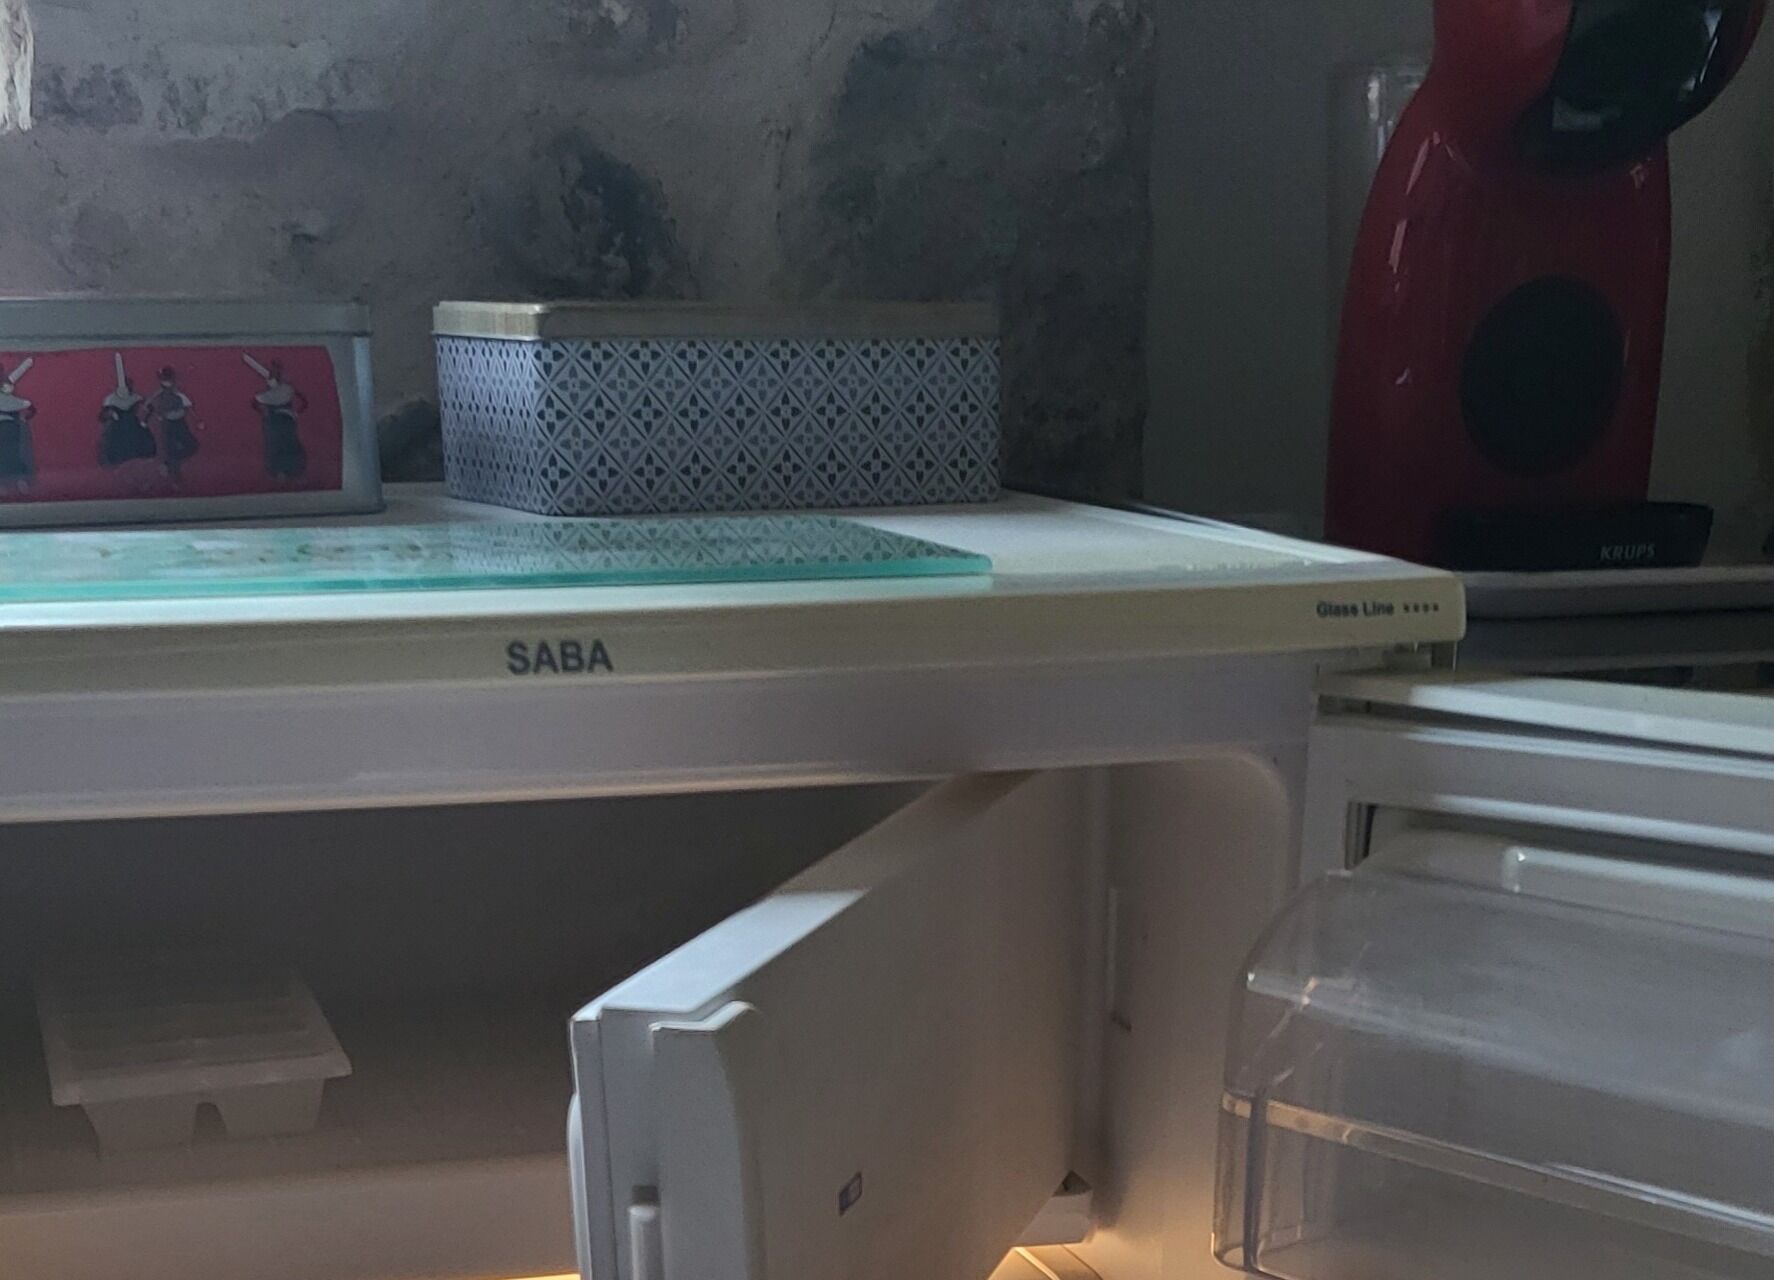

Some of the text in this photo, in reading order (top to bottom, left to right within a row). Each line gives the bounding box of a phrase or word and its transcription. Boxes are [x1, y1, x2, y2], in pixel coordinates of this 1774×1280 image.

[1600, 543, 1656, 560] KRUPS
[1316, 600, 1394, 618] Glass Line
[507, 638, 615, 676] SABA
